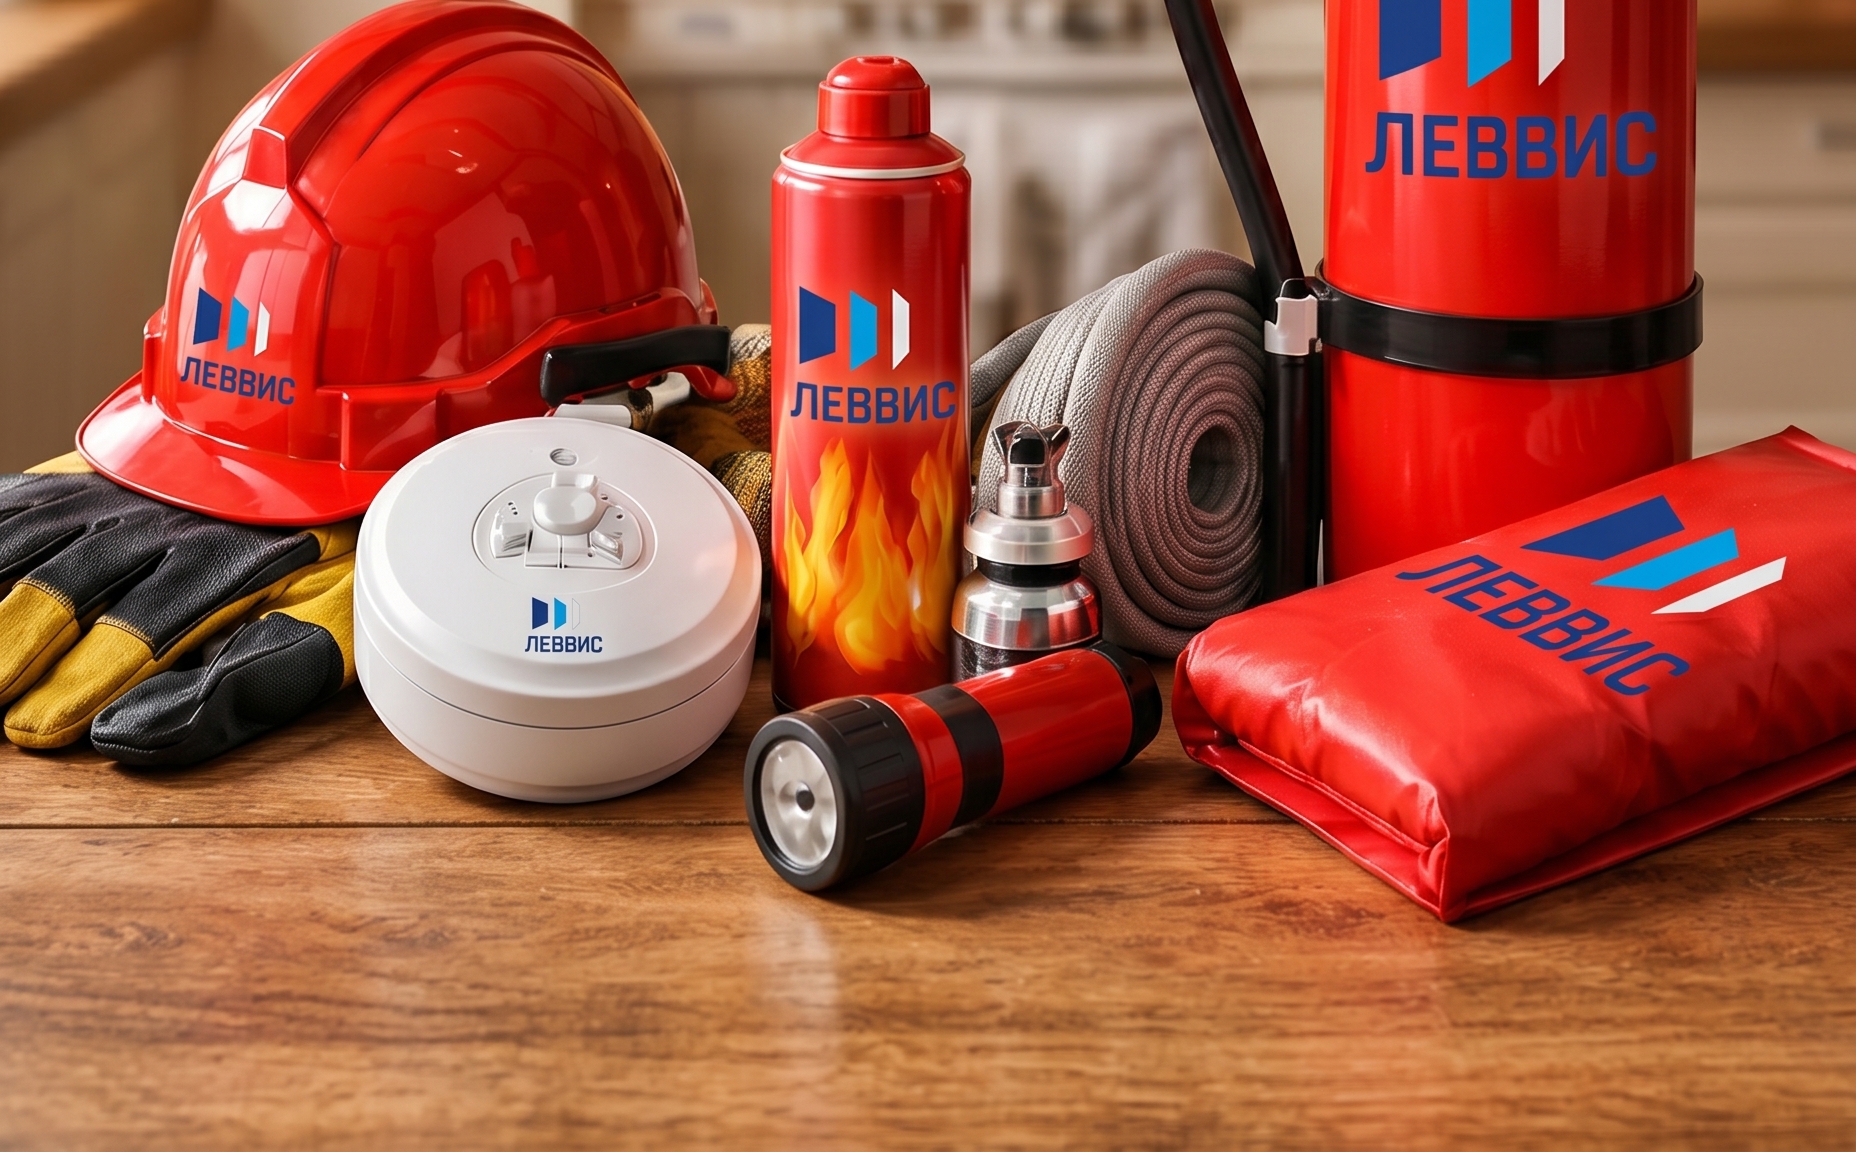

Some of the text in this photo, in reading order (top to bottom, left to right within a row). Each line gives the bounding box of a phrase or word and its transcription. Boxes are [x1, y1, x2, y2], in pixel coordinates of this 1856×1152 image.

[1365, 111, 1657, 178] ЛЕВВИС
[180, 356, 296, 405] ЛЕВВИС
[790, 381, 956, 424] ЛЕВВИС
[525, 636, 603, 653] ЛЕВВИС
[1395, 554, 1690, 696] ЛЕВВИС
